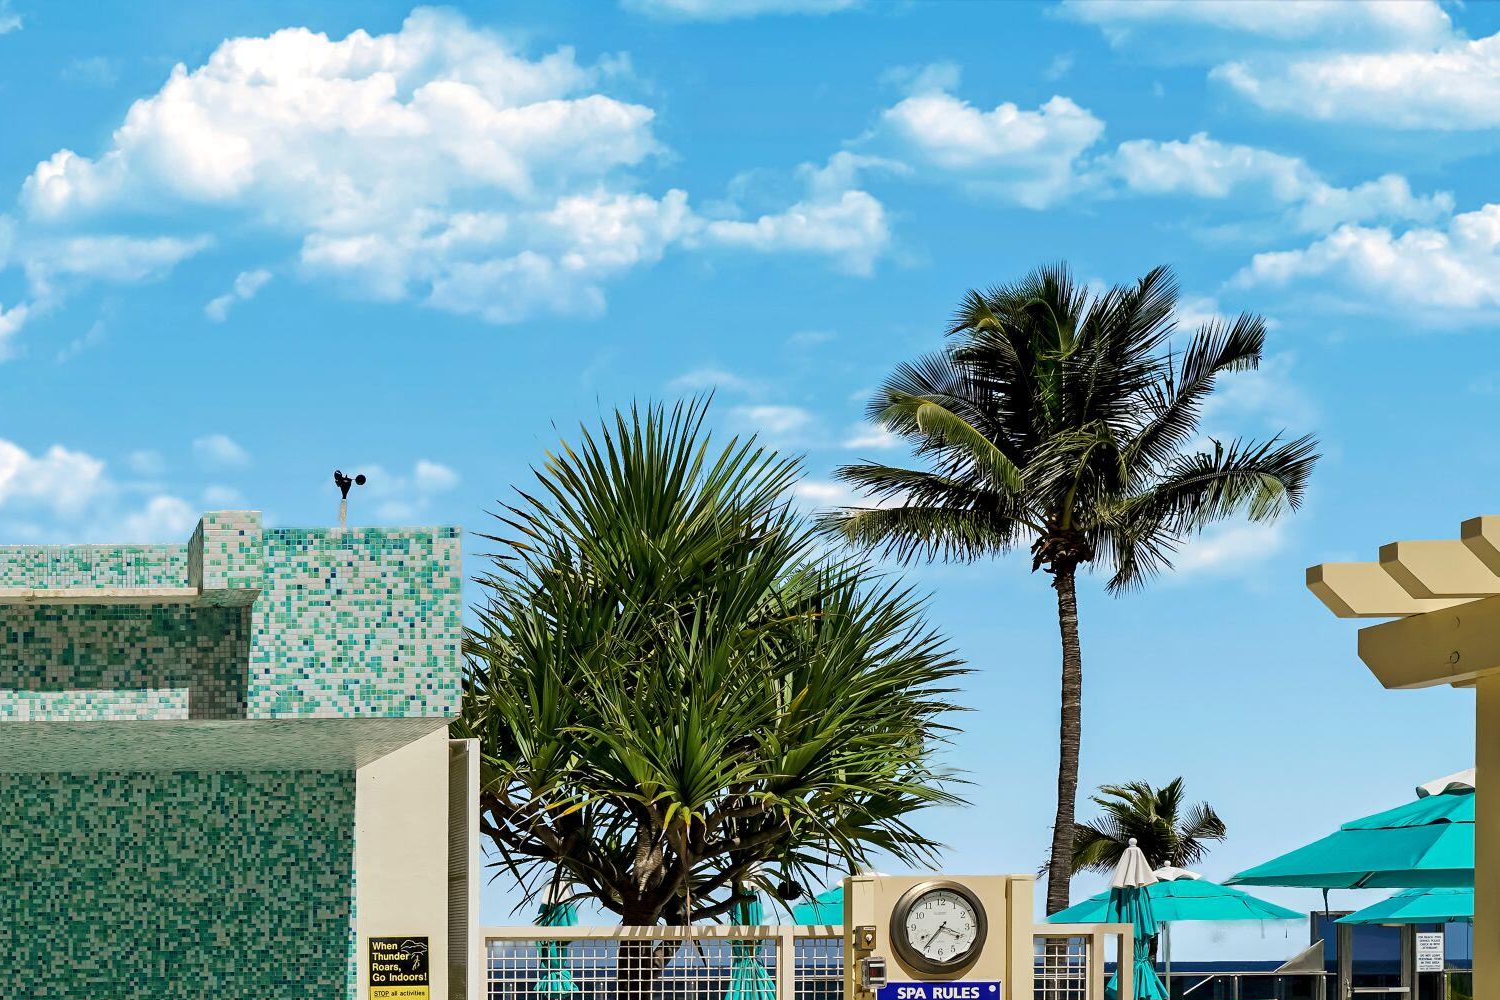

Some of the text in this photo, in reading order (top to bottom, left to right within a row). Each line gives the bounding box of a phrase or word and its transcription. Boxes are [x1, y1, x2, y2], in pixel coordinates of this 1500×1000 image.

[372, 942, 397, 950] When
[372, 964, 402, 972] Roars,
[372, 973, 427, 982] Go Indoors!
[898, 987, 979, 999] SPA RULES
